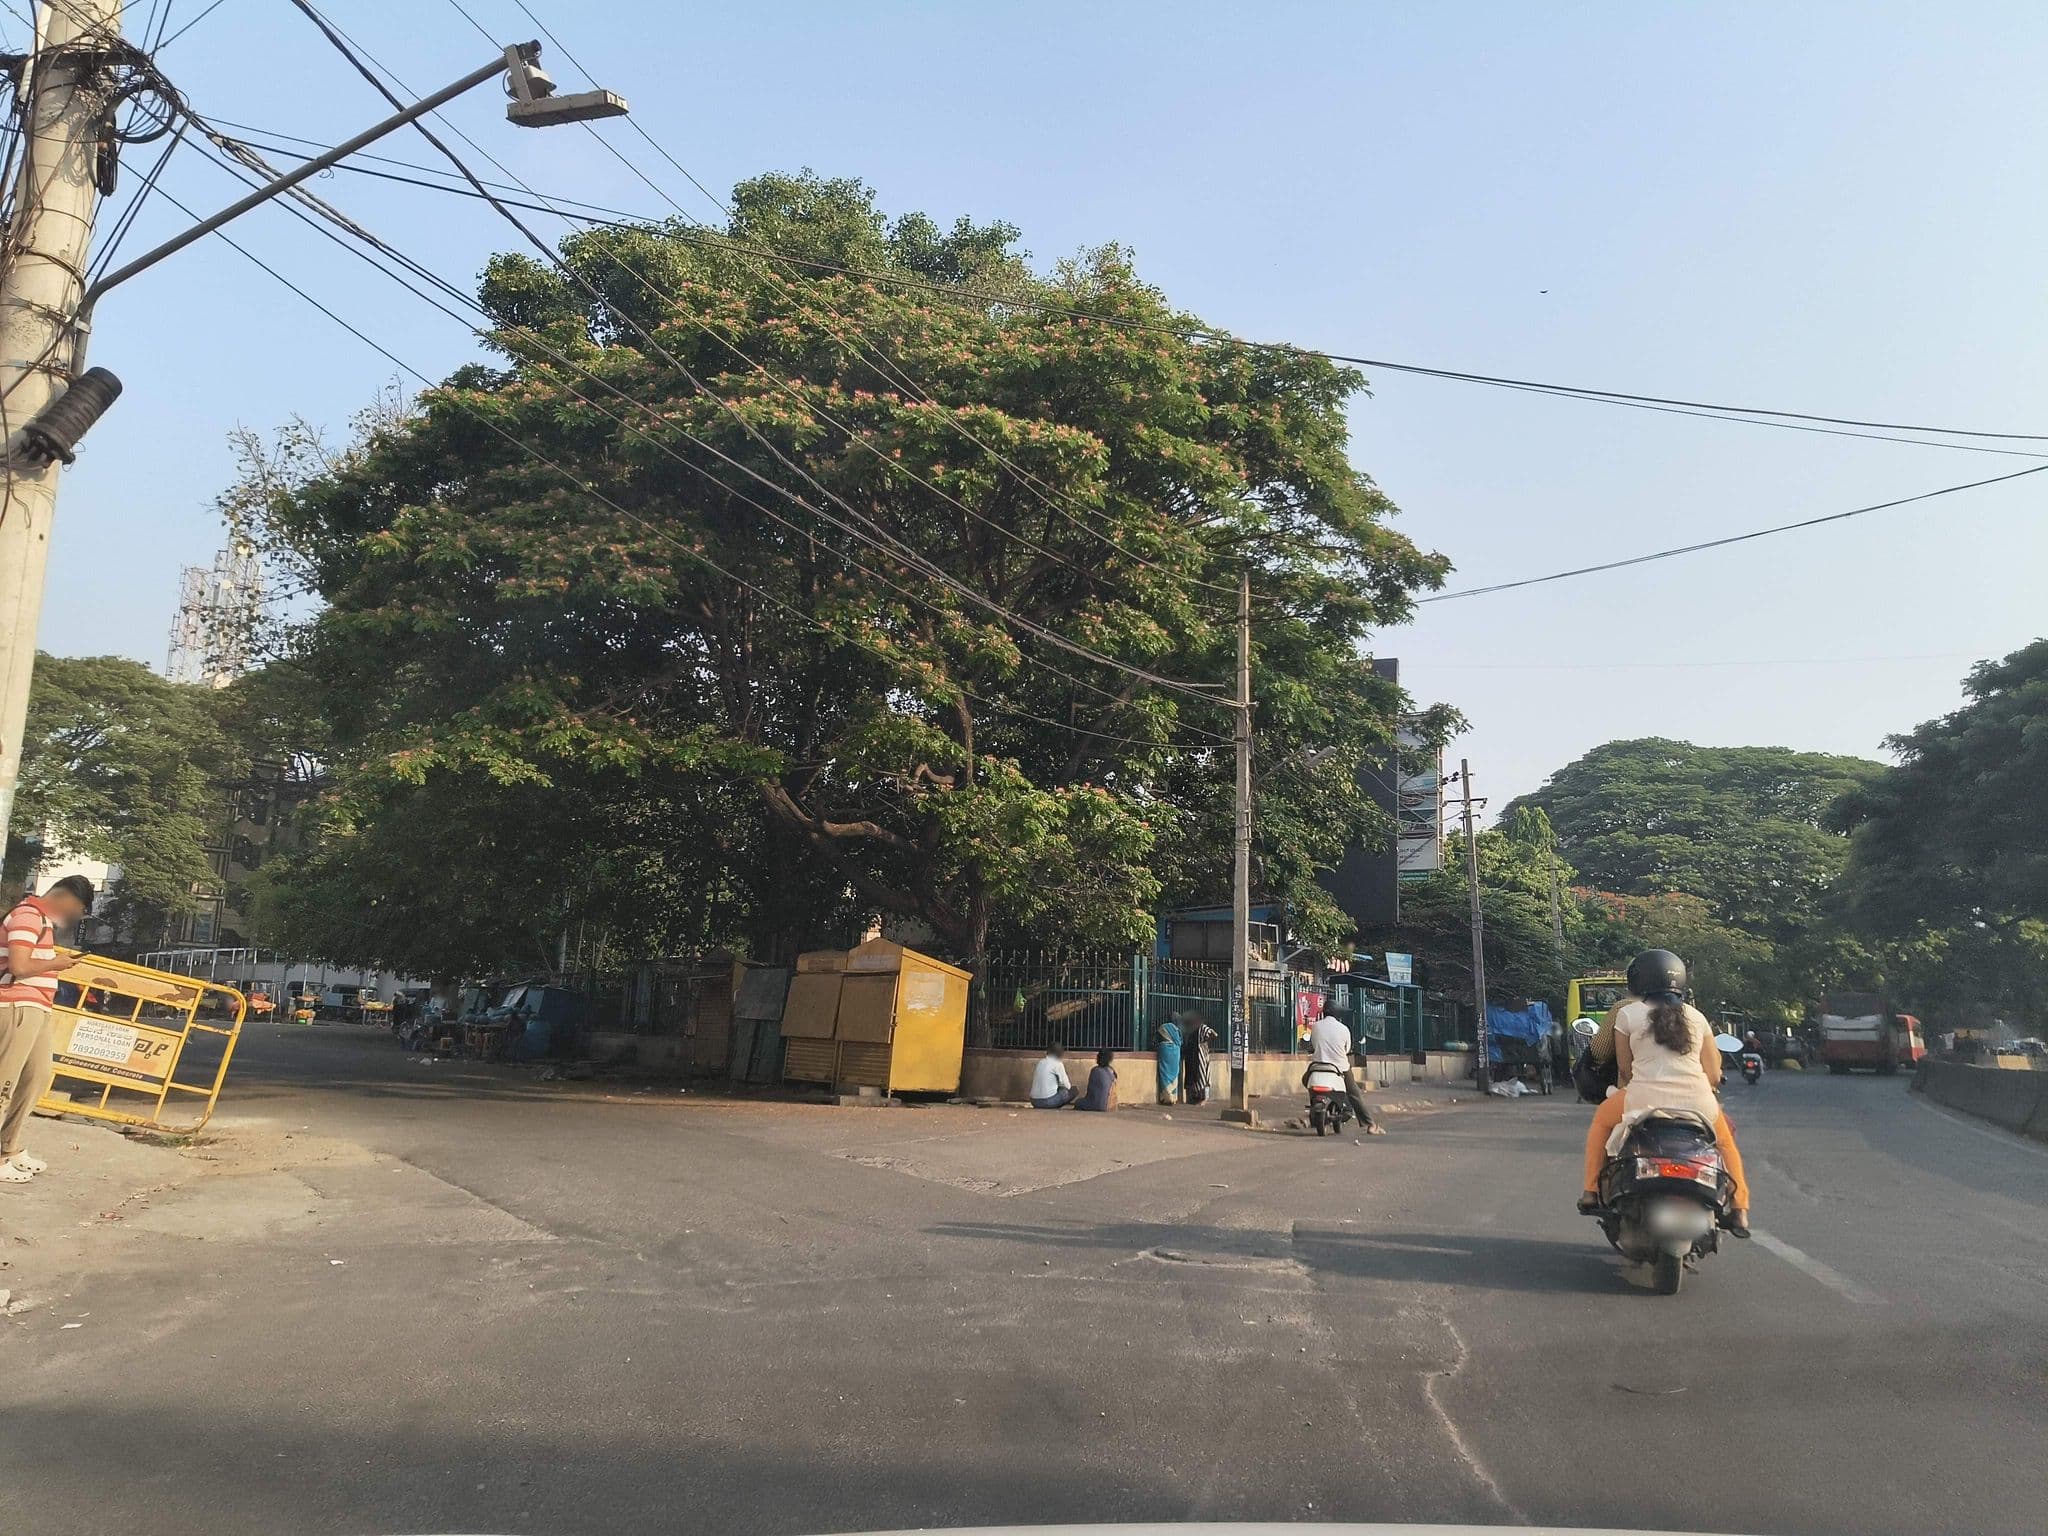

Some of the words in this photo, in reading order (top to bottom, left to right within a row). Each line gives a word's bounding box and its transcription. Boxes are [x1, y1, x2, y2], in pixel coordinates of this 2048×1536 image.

[76, 1031, 112, 1044] PERSONAL
[113, 1039, 131, 1048] LOAN
[73, 1043, 127, 1060] 7892082959
[59, 1056, 100, 1069] Engineered
[100, 1064, 111, 1073] for
[112, 1067, 144, 1079] Concrete
